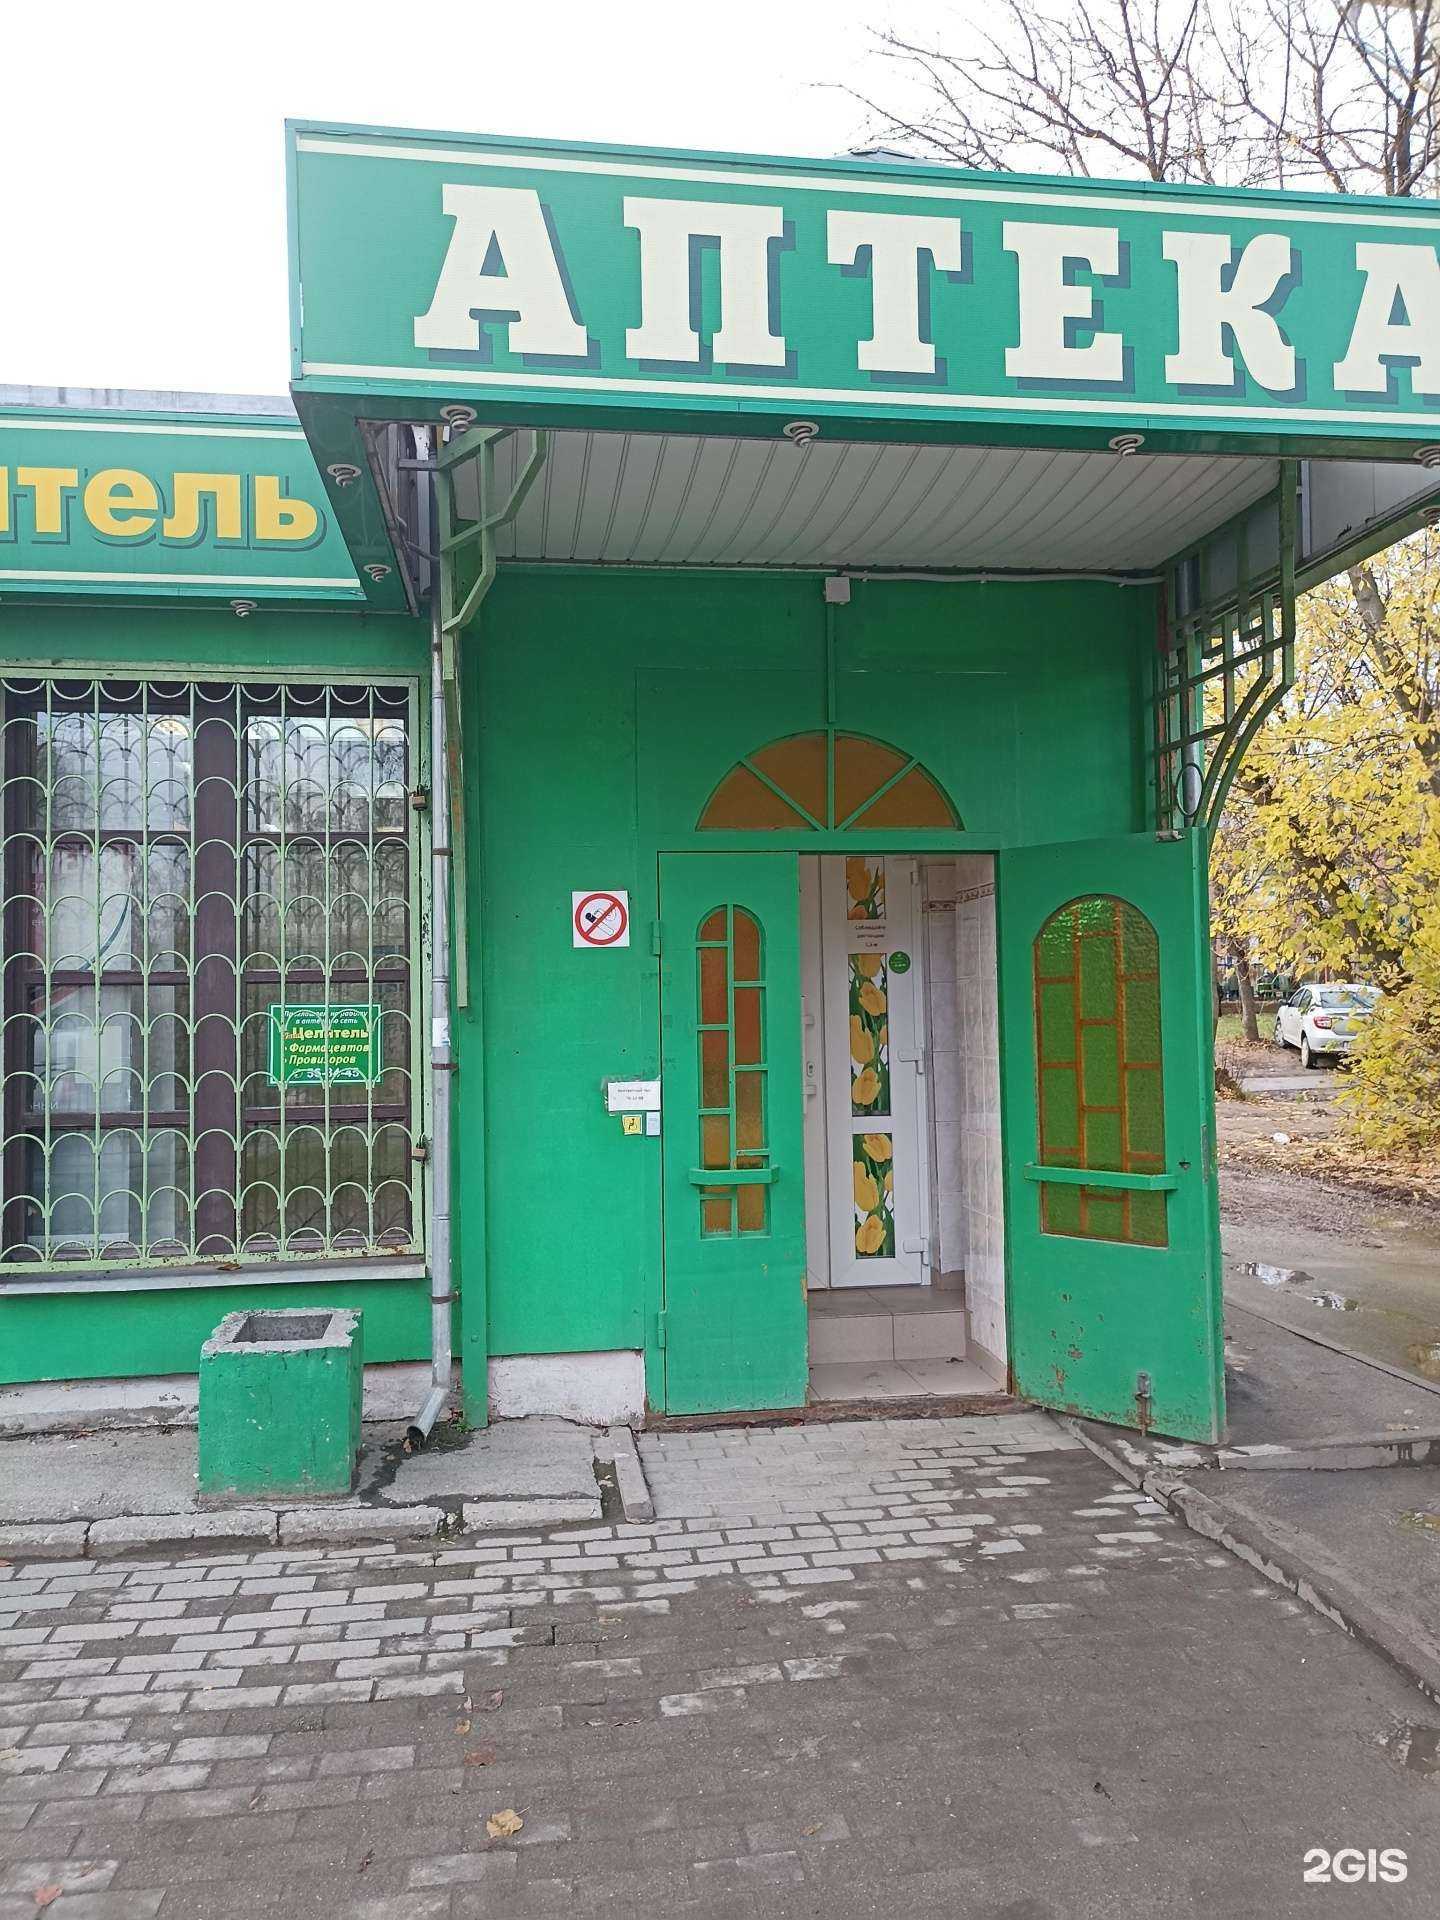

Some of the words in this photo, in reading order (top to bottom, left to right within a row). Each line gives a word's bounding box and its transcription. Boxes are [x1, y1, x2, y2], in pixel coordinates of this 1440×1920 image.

[414, 184, 1440, 396] АПТЕКА
[0, 466, 318, 541] тель
[289, 1055, 357, 1066] Провиоров
